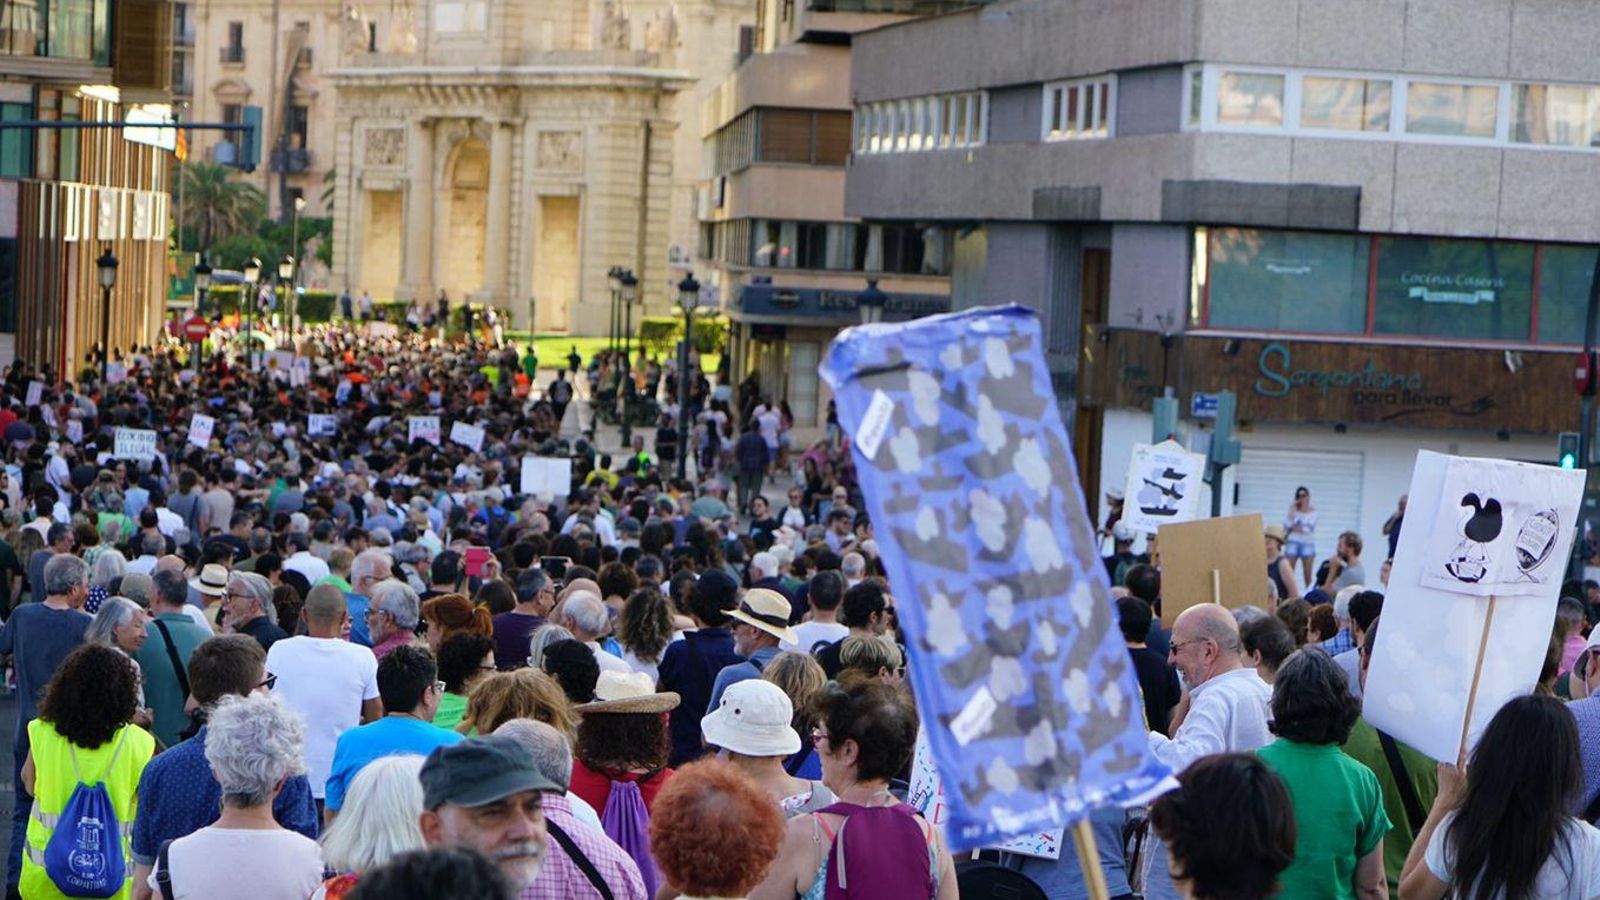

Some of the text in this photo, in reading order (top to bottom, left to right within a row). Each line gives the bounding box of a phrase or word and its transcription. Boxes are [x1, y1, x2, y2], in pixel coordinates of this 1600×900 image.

[1401, 271, 1453, 285] Cocina
[1353, 390, 1452, 407] para llevar
